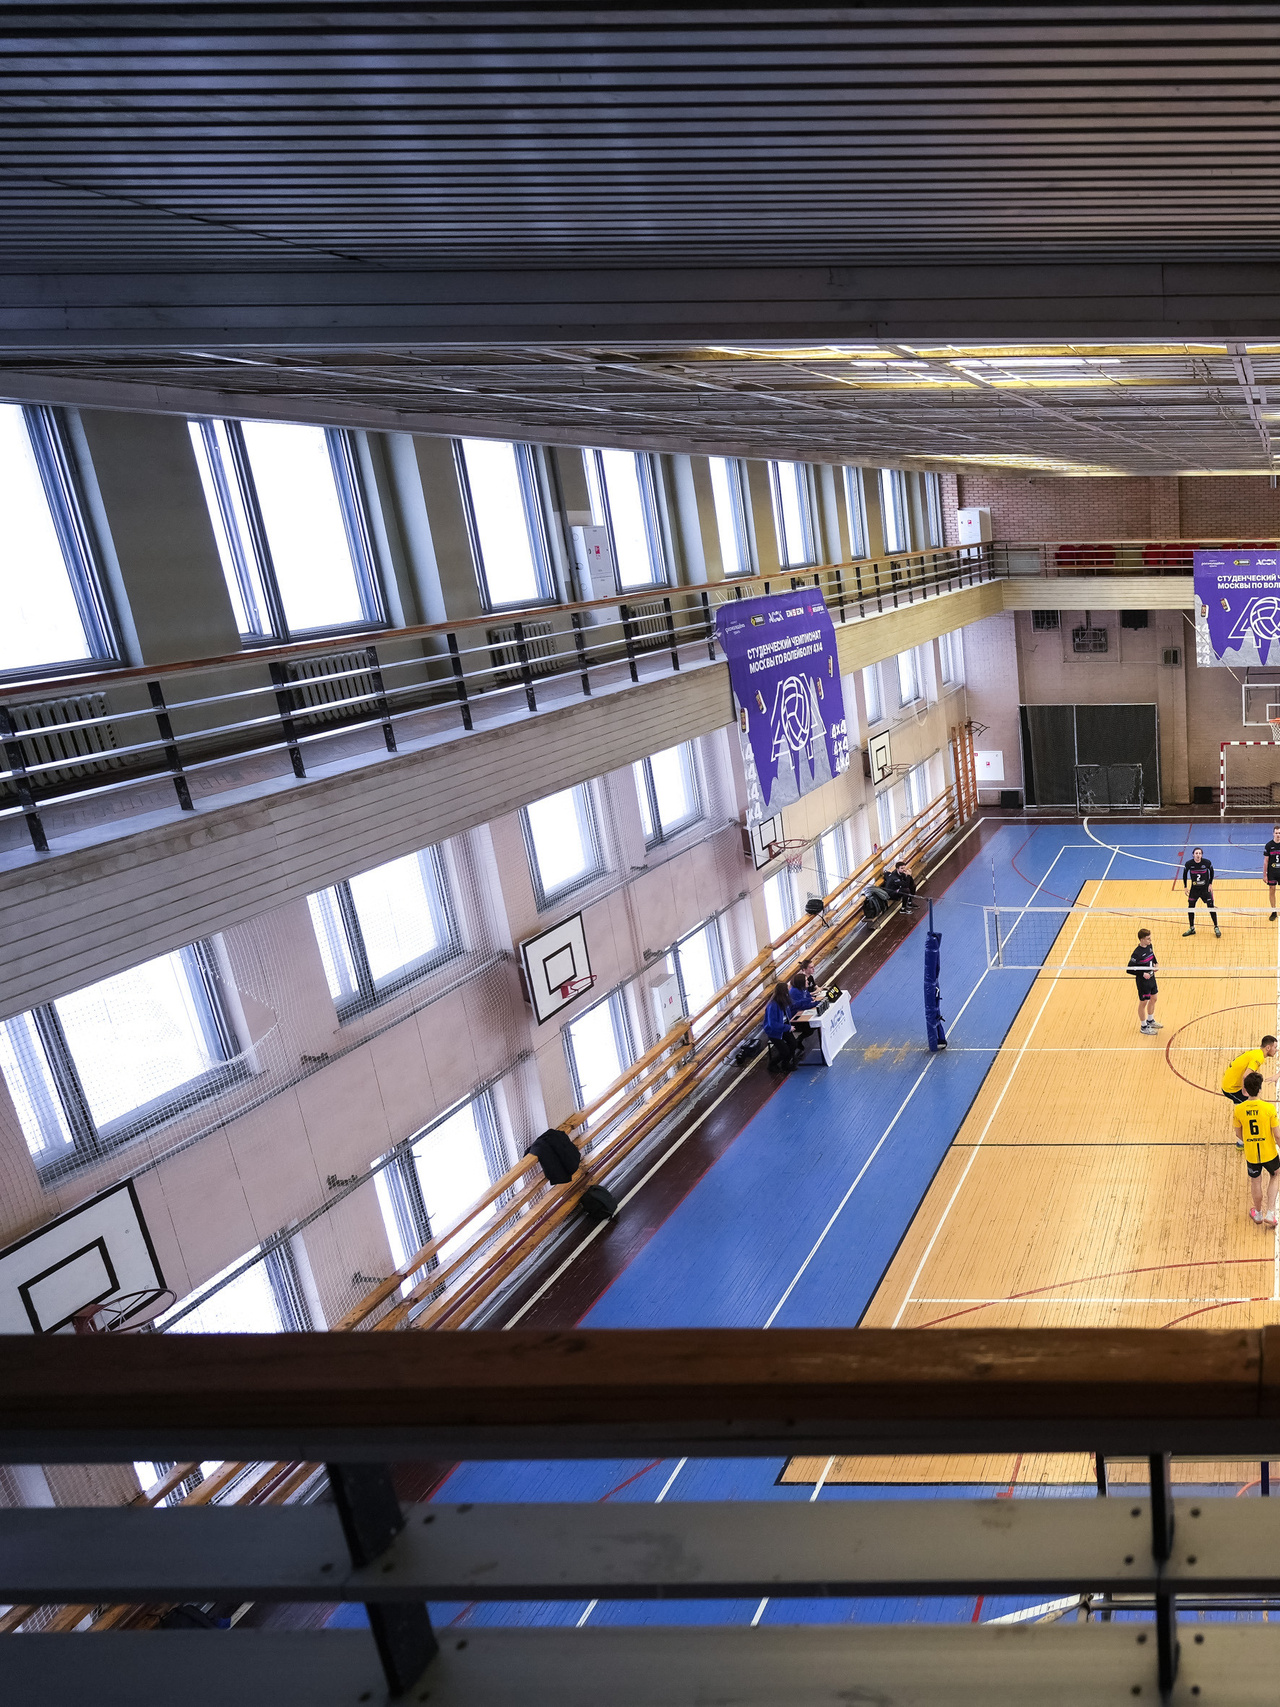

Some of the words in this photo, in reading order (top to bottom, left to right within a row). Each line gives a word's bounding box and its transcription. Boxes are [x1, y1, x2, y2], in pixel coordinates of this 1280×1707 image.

[1217, 574, 1277, 582] СТУДЕНЧЕСКИЙ
[747, 636, 792, 660] СТУДЕНЧЕСКИЙ
[791, 629, 822, 647] ЧЕМПИОНАТ
[774, 653, 784, 666] ПО
[783, 645, 813, 663] ВОЛЕЙБОЛУ
[1196, 873, 1201, 881] 2
[1249, 1119, 1260, 1136] 6
